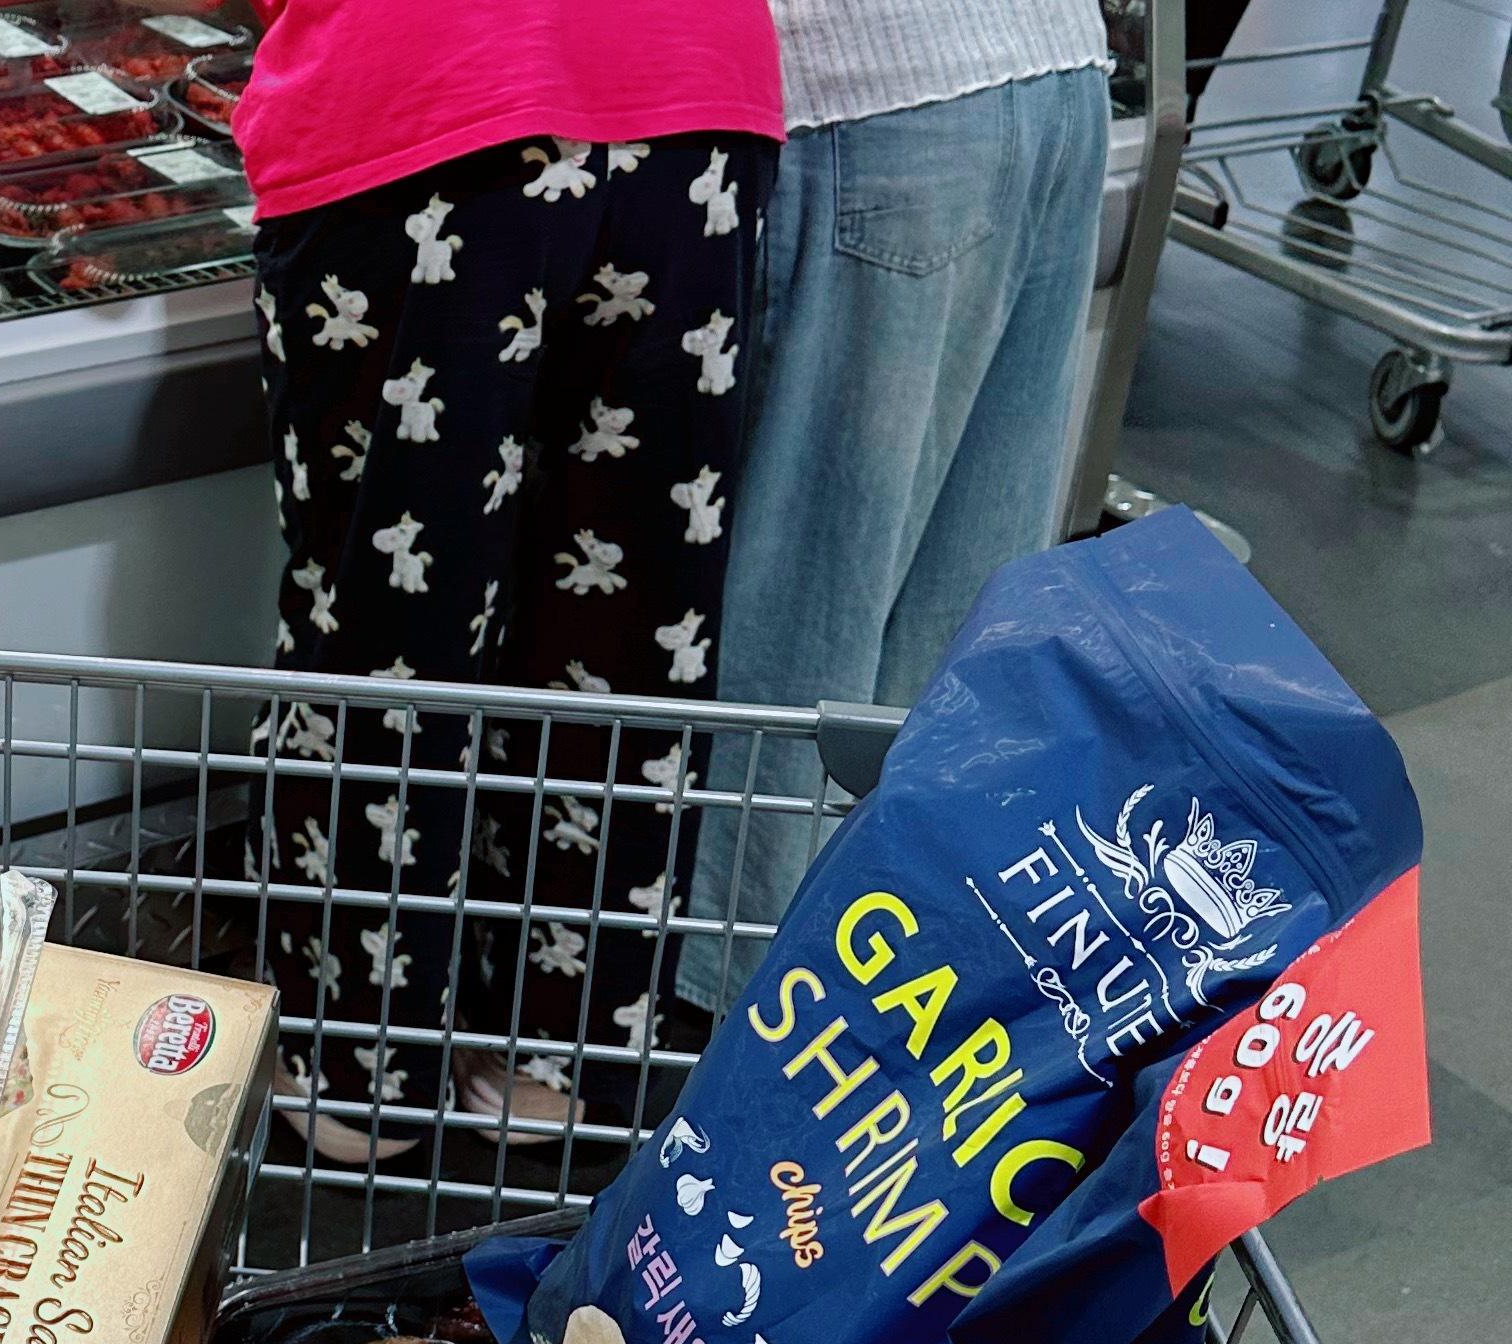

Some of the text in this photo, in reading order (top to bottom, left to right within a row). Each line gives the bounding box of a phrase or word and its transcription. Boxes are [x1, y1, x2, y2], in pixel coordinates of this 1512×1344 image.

[147, 995, 205, 1070] Beretta
[1261, 1011, 1375, 1163] 증량
[1, 1151, 73, 1233] THIN
[50, 1156, 145, 1288] Italian
[769, 1160, 826, 1269] chips
[626, 1214, 682, 1310] 갈릭
